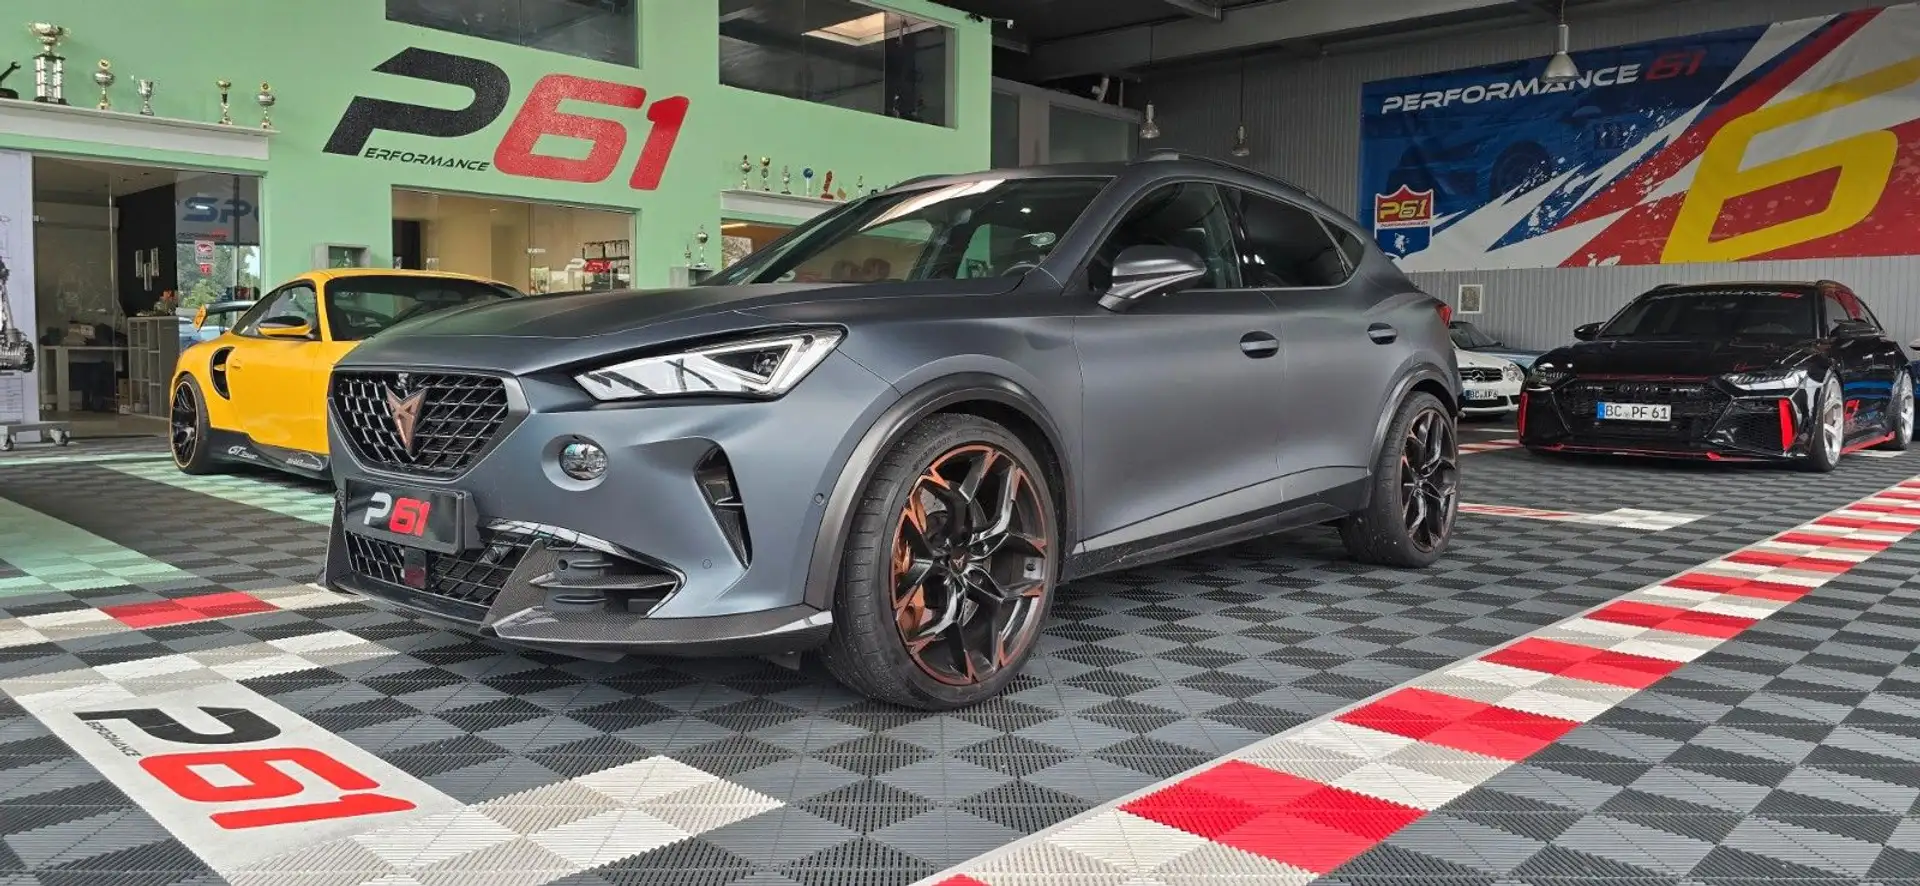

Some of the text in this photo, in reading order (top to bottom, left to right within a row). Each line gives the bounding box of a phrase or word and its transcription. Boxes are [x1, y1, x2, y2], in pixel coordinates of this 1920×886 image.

[1645, 49, 1708, 81] 61
[364, 147, 491, 172] ERFORMANCE
[1380, 199, 1428, 220] P61
[1605, 405, 1668, 420] BC PF 61
[363, 491, 431, 537] P61
